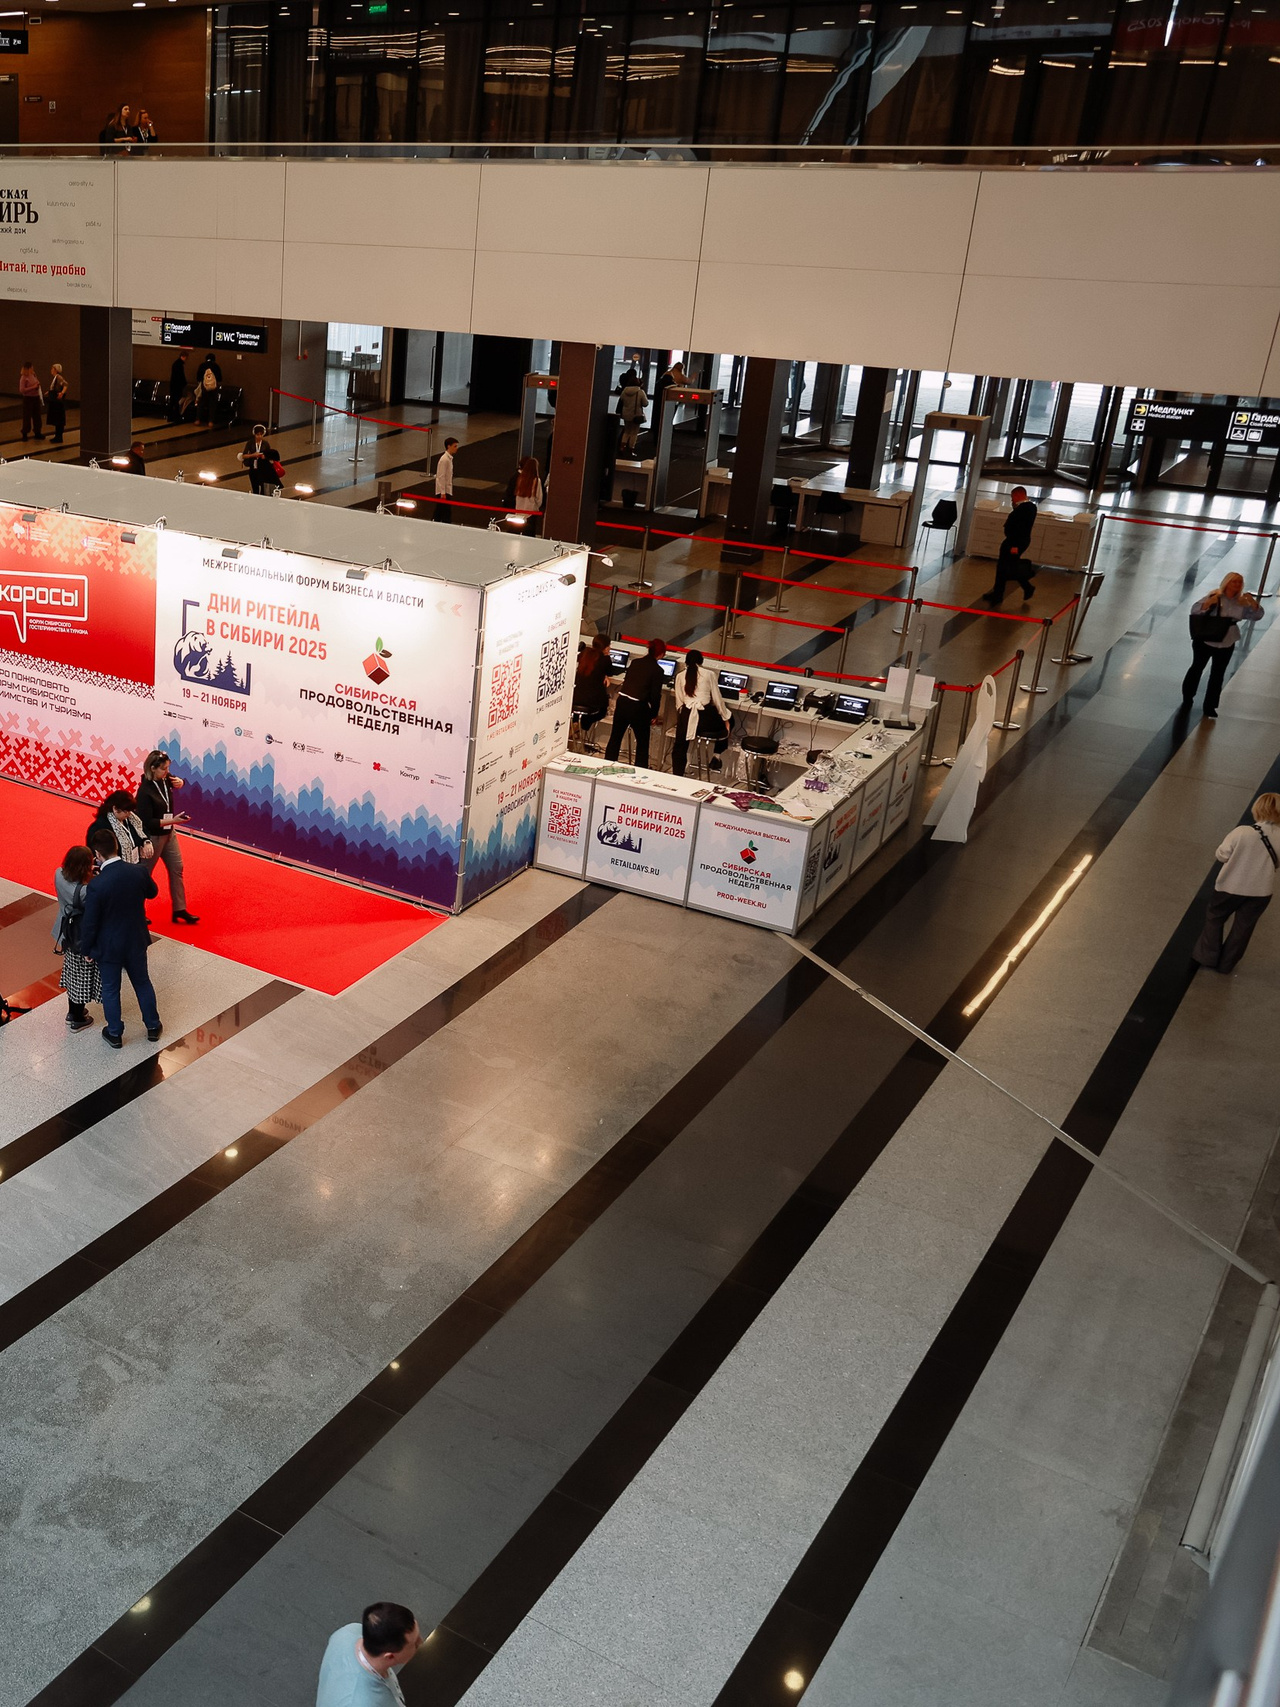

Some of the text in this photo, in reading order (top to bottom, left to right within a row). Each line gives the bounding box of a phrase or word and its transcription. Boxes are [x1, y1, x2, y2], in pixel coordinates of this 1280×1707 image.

[14, 227, 27, 235] дом
[30, 264, 48, 275] где
[50, 264, 86, 276] удобно
[223, 333, 235, 342] WC
[236, 331, 260, 340] Туалетные
[1149, 404, 1195, 416] Медпункт
[202, 558, 424, 608] МЕЖРЕГИОНАЛЬНЫЙ ФОРУМ БИЗНЕСА И ВЛАСТИ
[207, 592, 320, 632] ДНИ РИТЕЙЛА
[206, 618, 327, 661] В СИБИРИ 2025
[11, 671, 70, 693] ПОЖАЛОВАТЬ
[21, 685, 77, 706] СИБИРСКОГО
[182, 687, 193, 699] 19
[200, 690, 210, 702] 21
[211, 692, 247, 713] НОЯБРЯ
[334, 682, 417, 712] СИБИРСКАЯ
[41, 701, 48, 709] И
[49, 704, 92, 721] ТУРИЗМА
[299, 688, 453, 735] ПРОДОВОЛЬСТВЕННАЯ
[347, 713, 400, 737] НЕДЕЛЯ
[399, 770, 420, 781] Контур
[497, 791, 505, 804] 19
[510, 784, 518, 798] 21
[518, 769, 543, 792] НОЯБРЯ
[500, 788, 537, 818] НОВОСИБИРСК
[619, 803, 683, 826] ДНИ РИТЕЙЛА
[617, 815, 686, 840] В СИБИРИ 2025
[714, 821, 791, 844] МЕЖДУНАРОДНАЯ ВЫСТАВКА
[610, 857, 660, 877] RETAILDAYS.RU
[700, 863, 792, 892] ПРОДОВОЛЬСТВЕННАЯ
[722, 861, 772, 879] СИБИРСКАЯ
[728, 877, 761, 891] НЕДЕЛЯ
[716, 890, 768, 910] PROD-WEEK.RU
